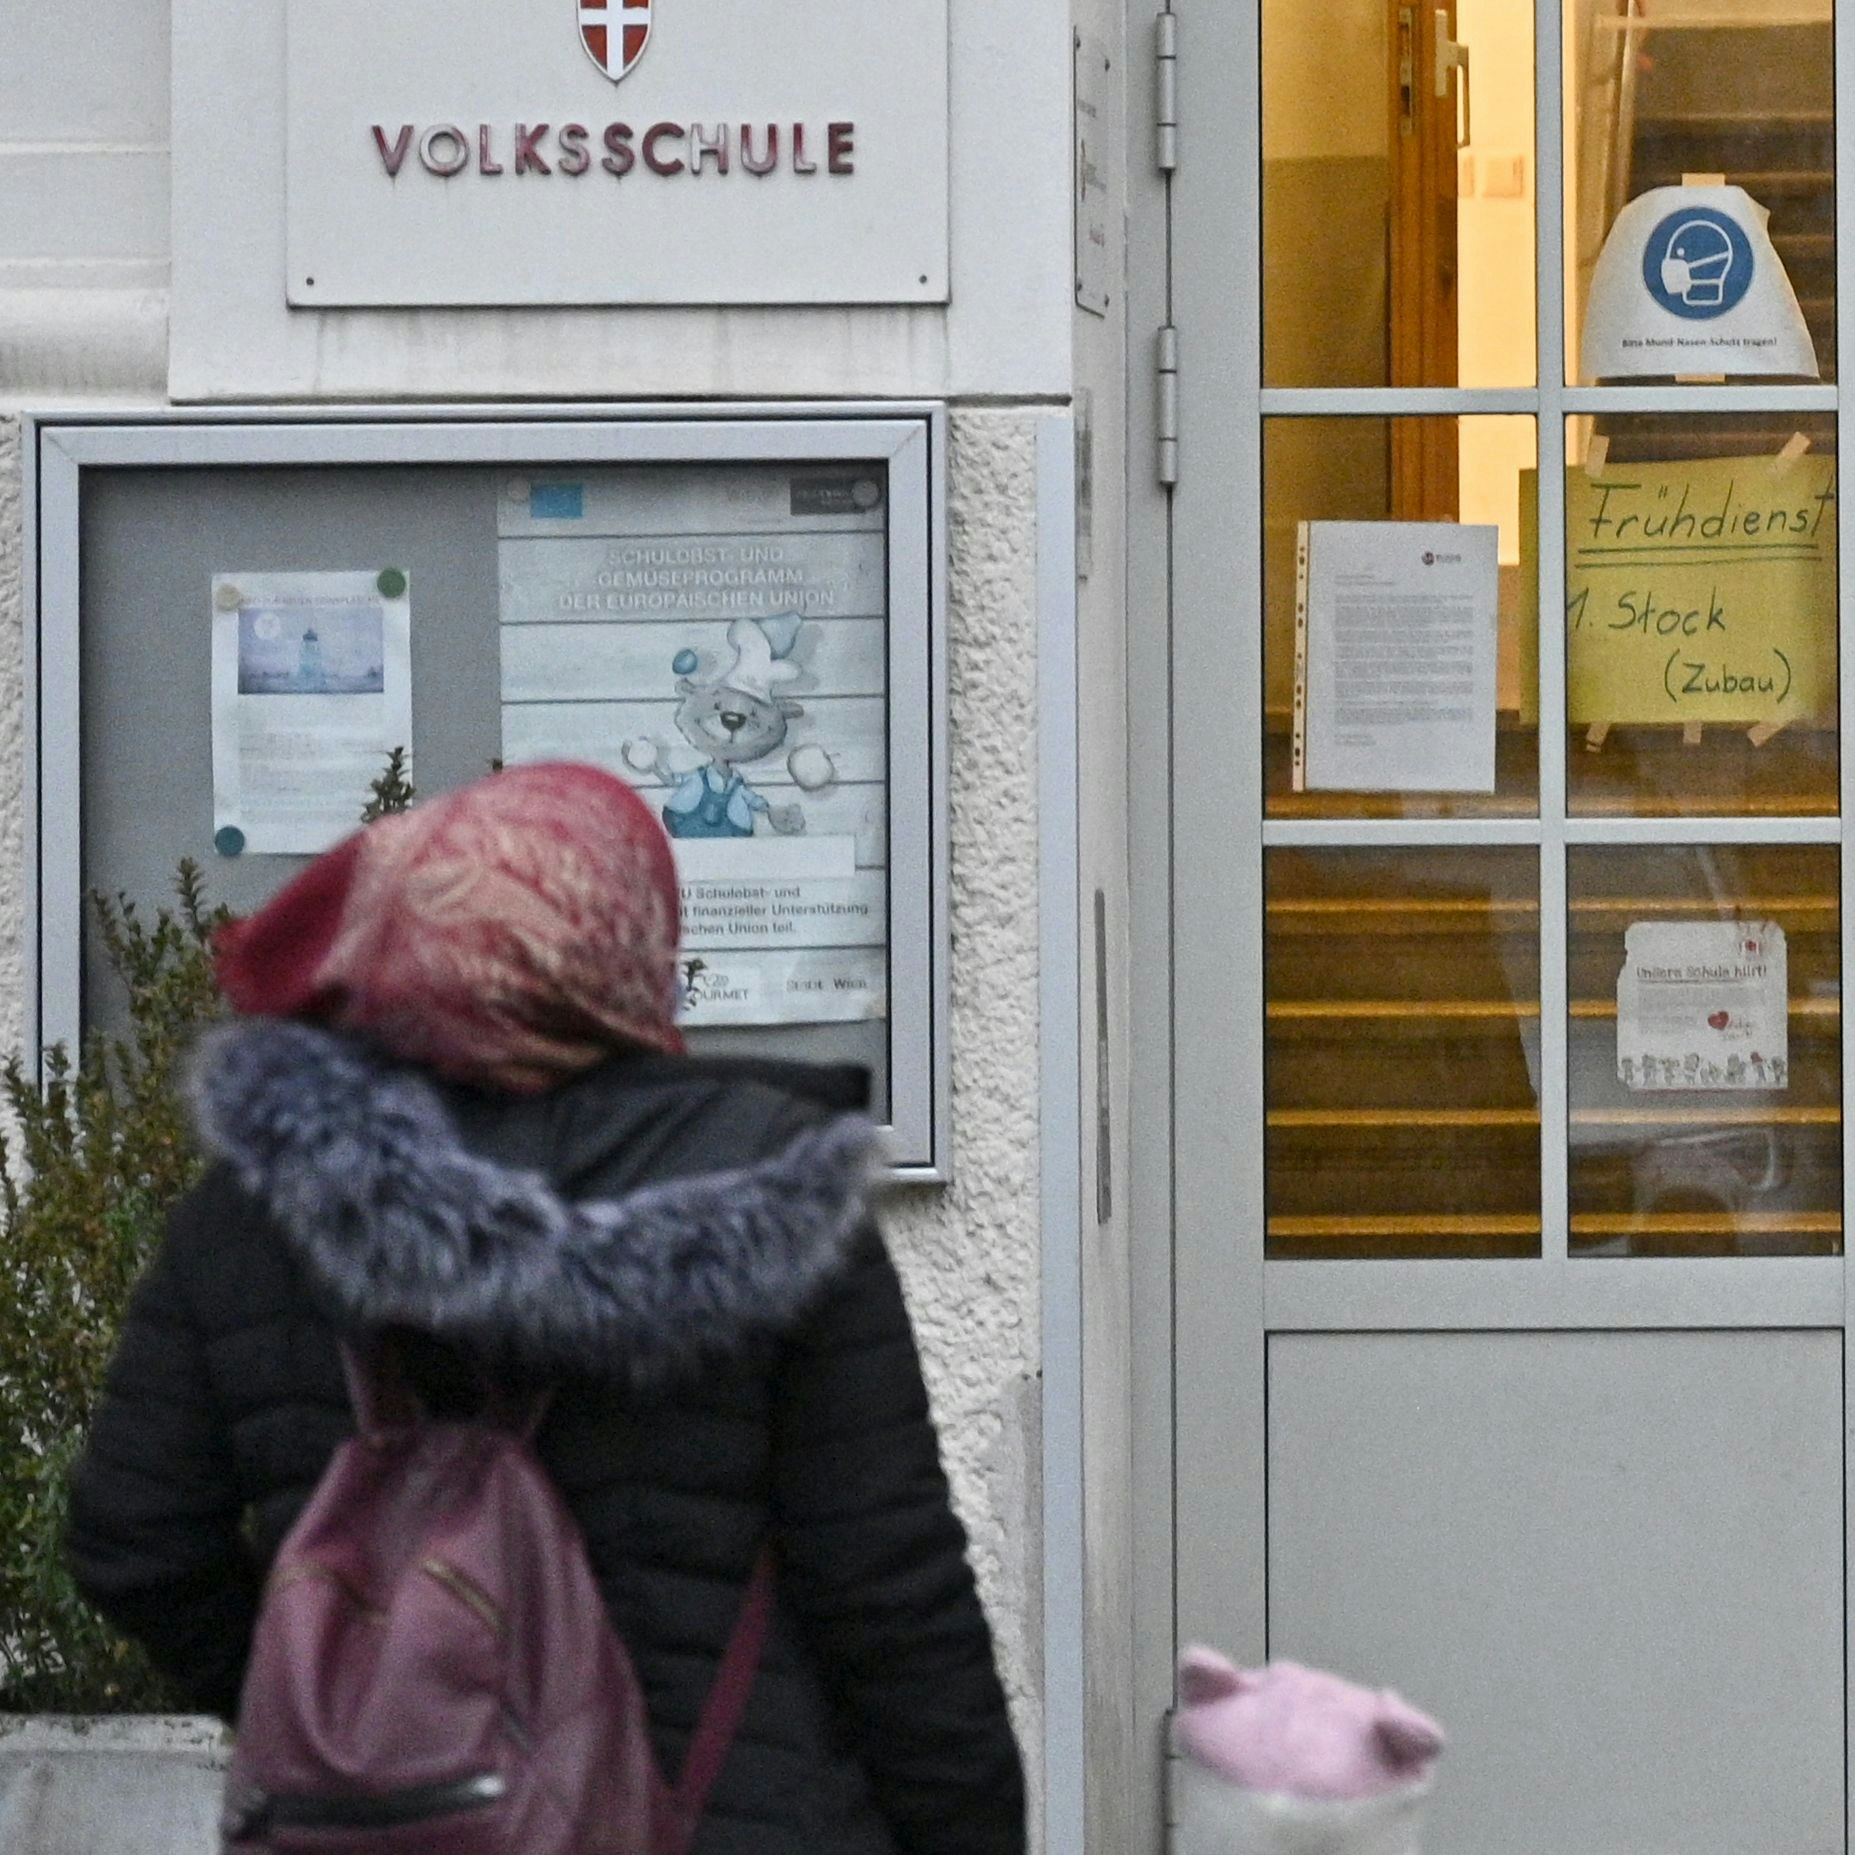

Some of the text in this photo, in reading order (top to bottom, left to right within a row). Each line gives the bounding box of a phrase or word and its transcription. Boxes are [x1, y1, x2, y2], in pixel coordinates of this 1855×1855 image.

[371, 121, 855, 177] VOLKSSCHULE
[1589, 473, 1836, 539] Frühdienst
[740, 546, 783, 562] UND
[598, 567, 803, 588] GEMÜSEPROGRAMM
[560, 594, 599, 610] DER
[769, 588, 834, 606] UNION
[1566, 585, 1726, 635] 1. Stock
[1664, 647, 1792, 704] (Zubau)
[774, 885, 801, 899] und
[692, 903, 767, 918] finanzieller
[771, 902, 869, 917] Unterstützung
[728, 921, 769, 936] Union
[1636, 966, 1683, 979] Unsere
[1687, 964, 1730, 978] Schule
[833, 976, 868, 991] Wien
[692, 988, 749, 1001] OURMET
